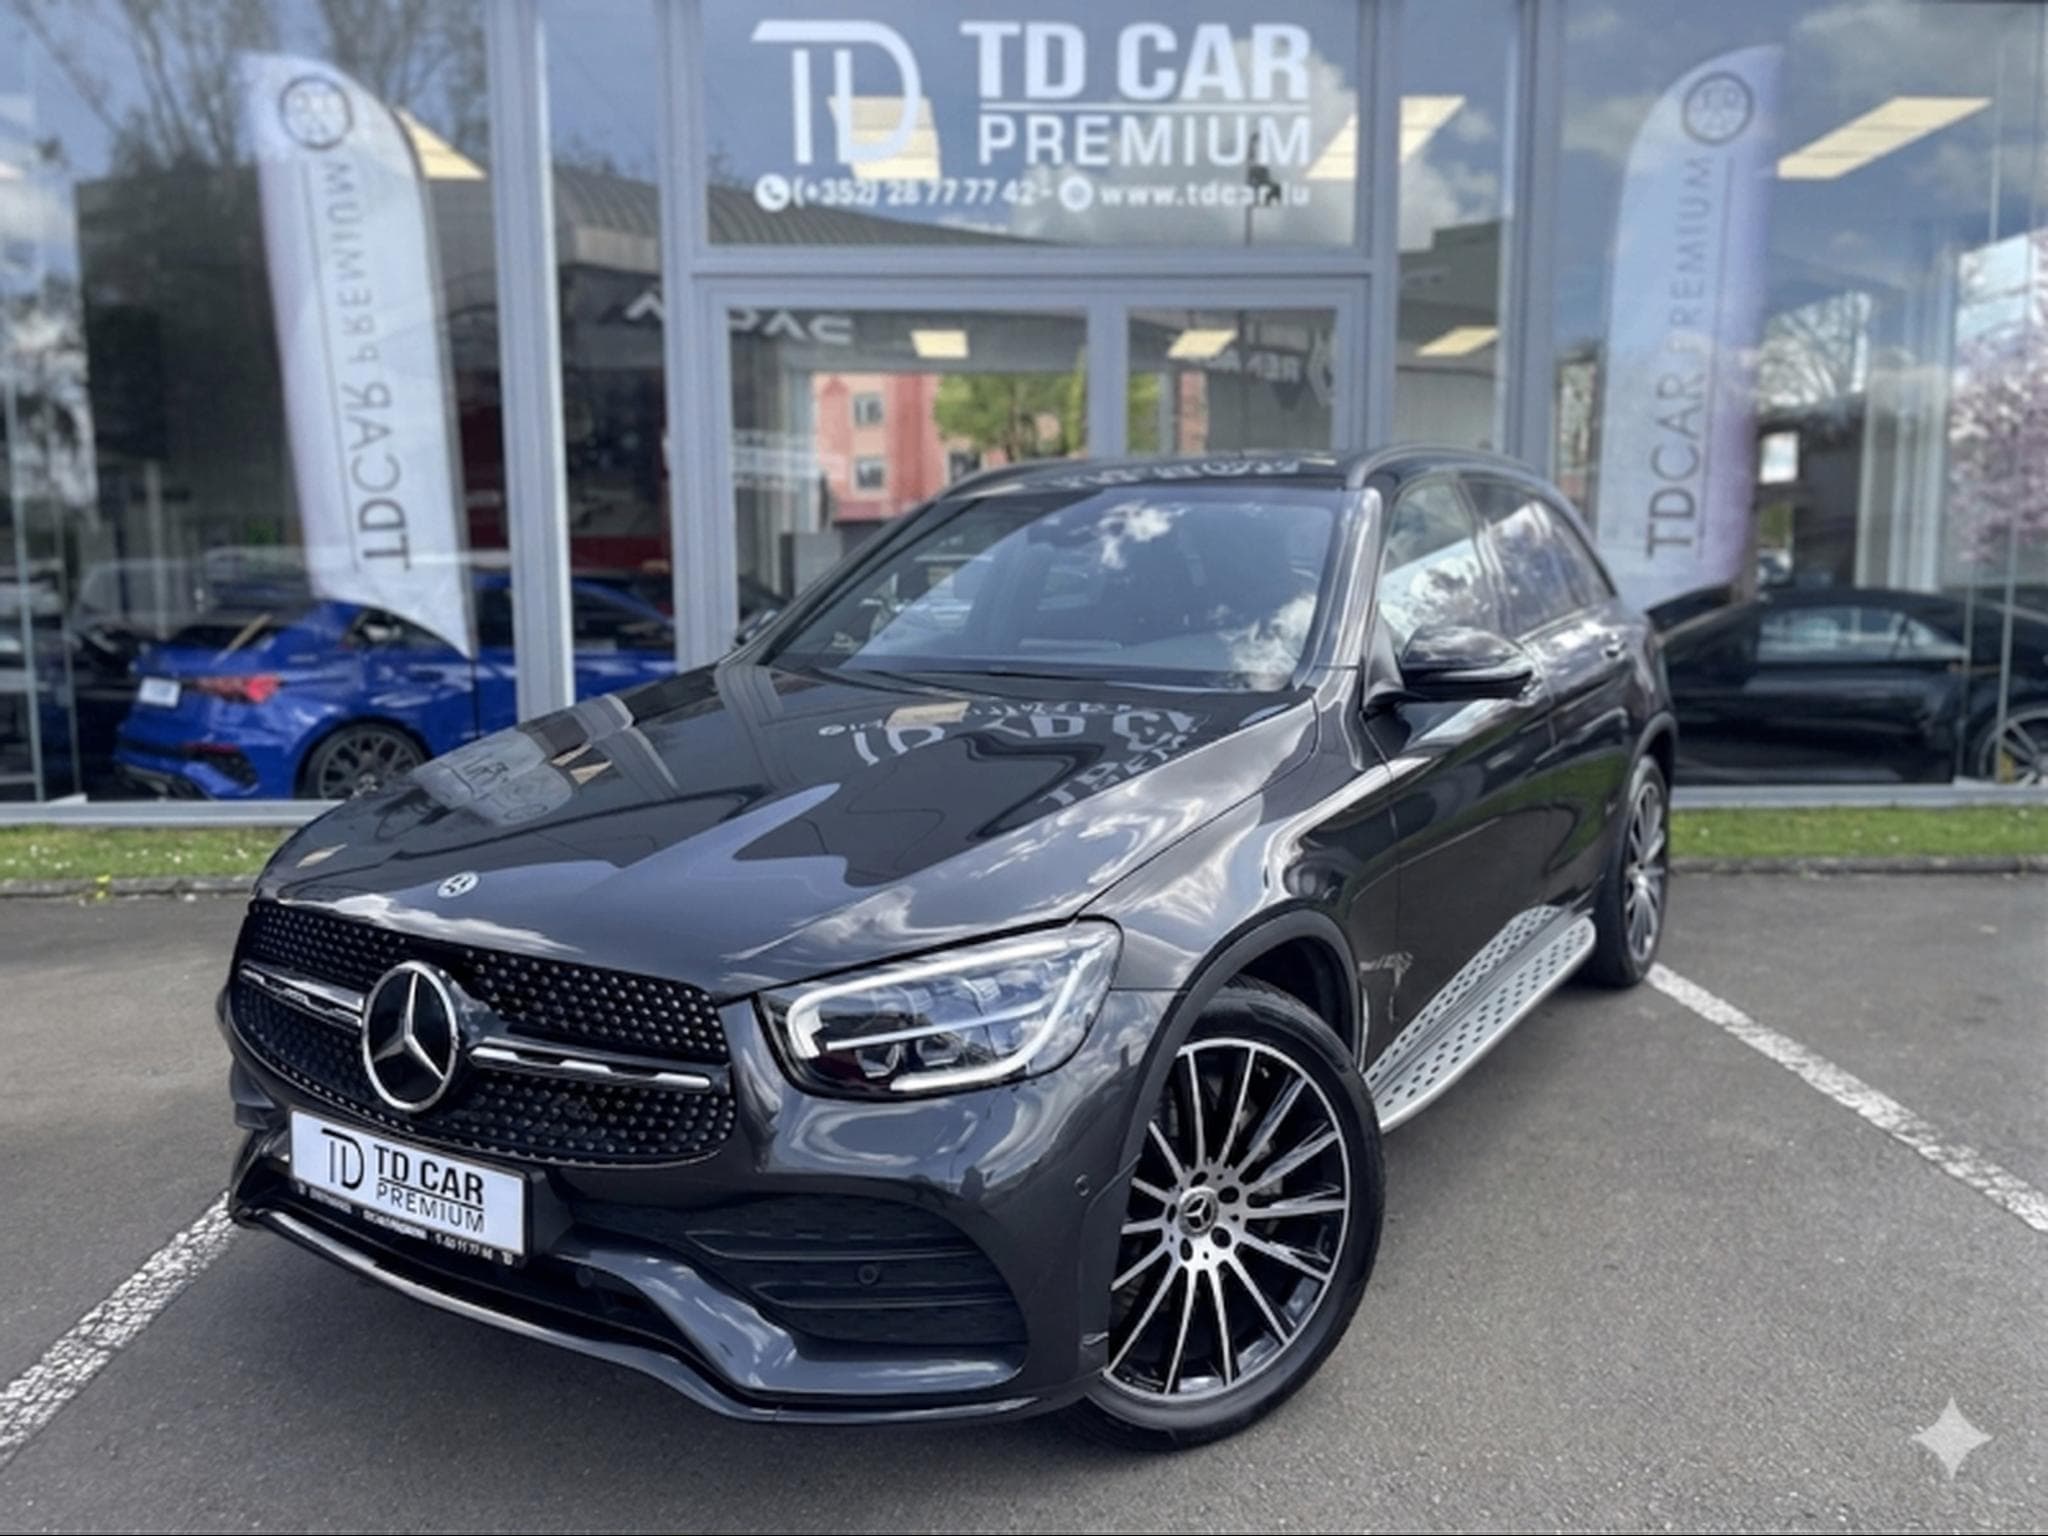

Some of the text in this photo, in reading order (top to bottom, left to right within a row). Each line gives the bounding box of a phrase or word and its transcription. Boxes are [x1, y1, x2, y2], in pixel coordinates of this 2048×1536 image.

[960, 22, 1311, 100] TD CAR
[978, 115, 1311, 167] PREMIUM
[1645, 373, 1704, 560] TDCAR
[373, 1143, 483, 1206] TD CAR
[376, 1181, 484, 1233] PREMIUM
